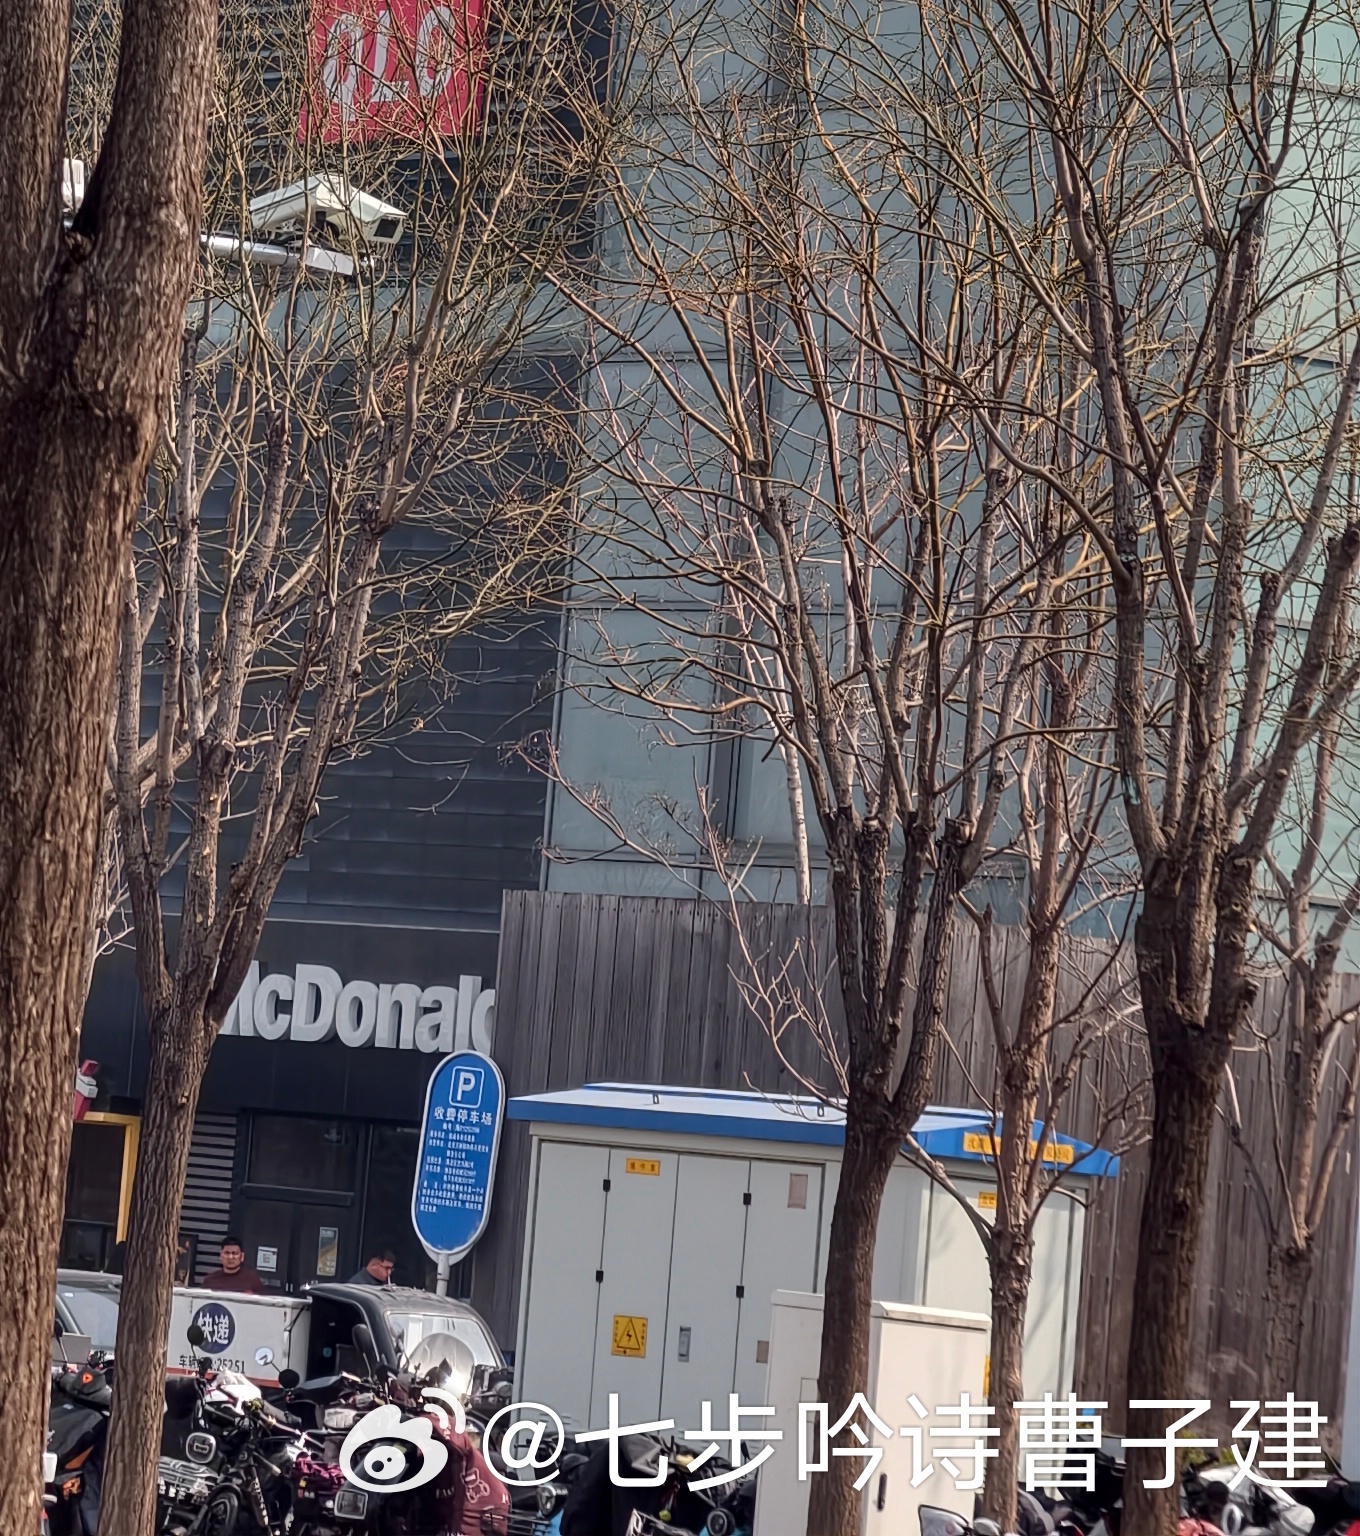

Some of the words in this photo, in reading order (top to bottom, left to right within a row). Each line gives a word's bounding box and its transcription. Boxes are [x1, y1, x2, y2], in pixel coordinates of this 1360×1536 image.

[323, 6, 456, 123] QLO
[456, 1072, 476, 1101] P
[434, 1106, 493, 1126] 收费停车场
[197, 1310, 230, 1345] 快递
[179, 1353, 246, 1375] 车辆:25251
